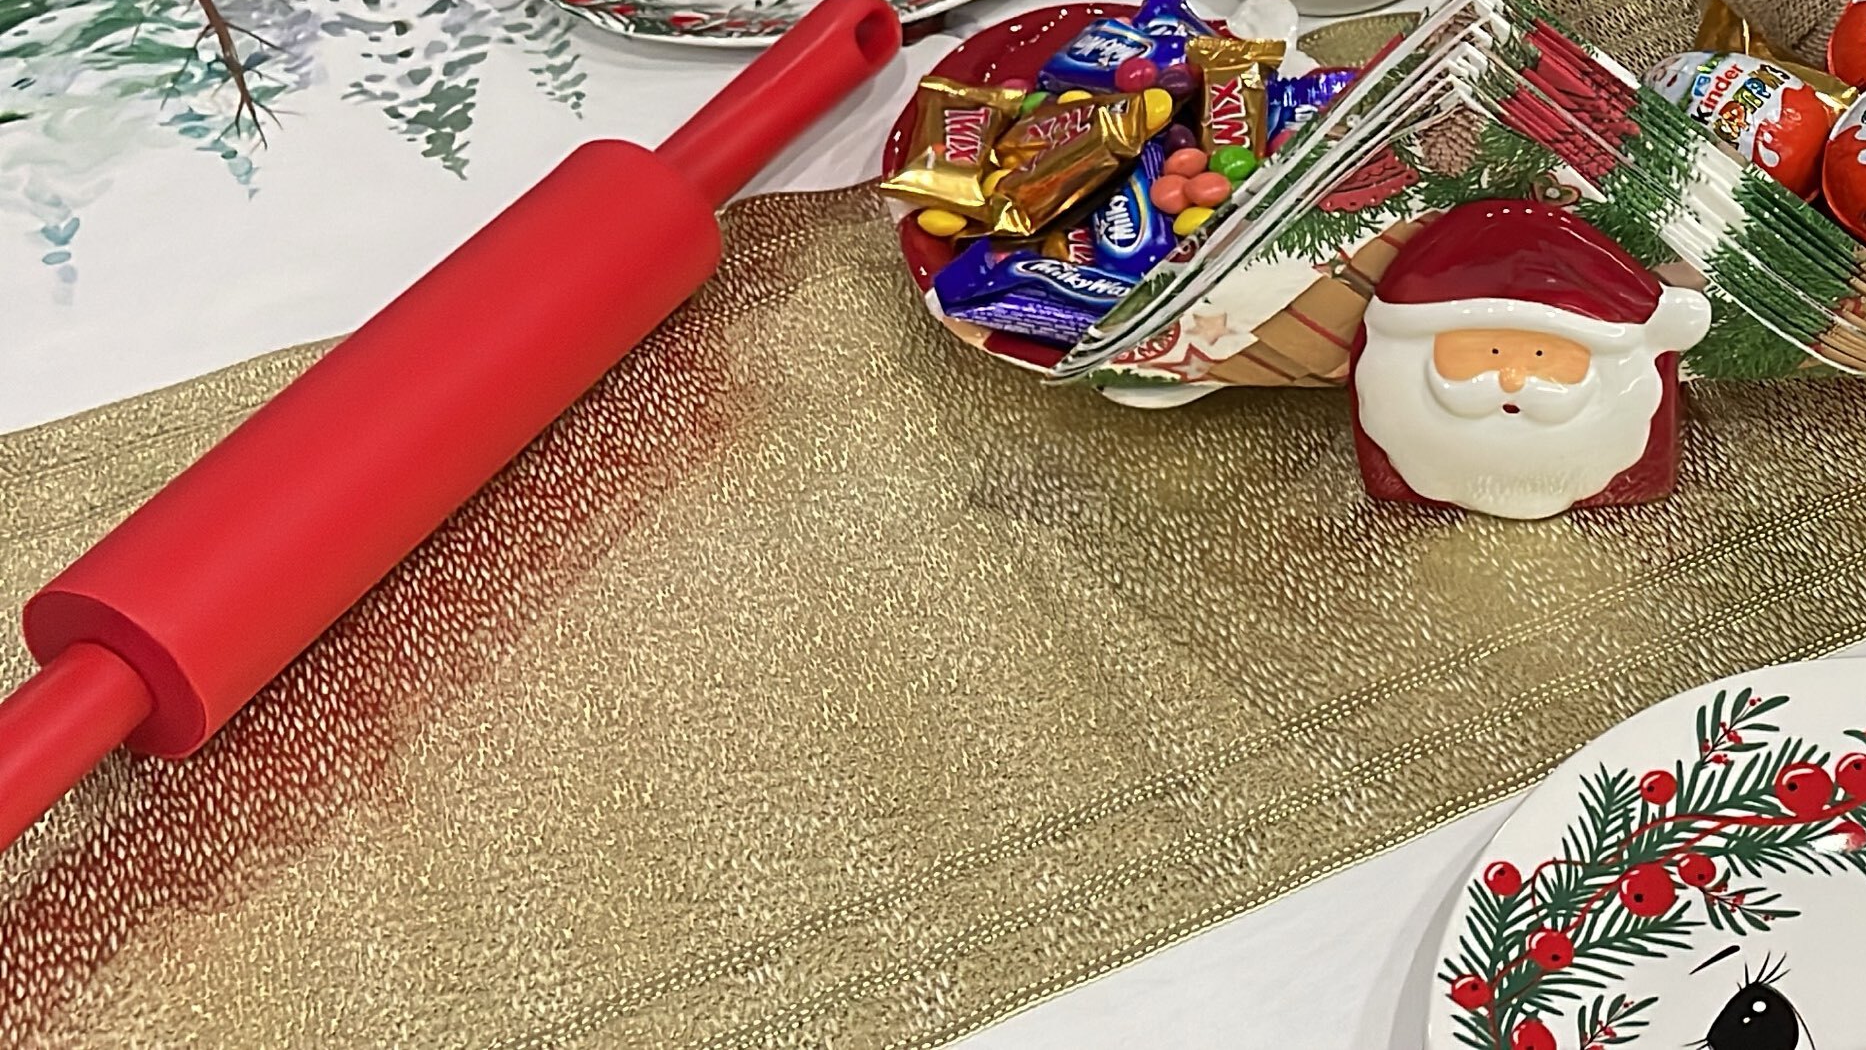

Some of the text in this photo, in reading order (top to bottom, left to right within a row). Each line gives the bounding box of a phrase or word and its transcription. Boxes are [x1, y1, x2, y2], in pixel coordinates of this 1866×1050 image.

[1203, 76, 1251, 148] WIX
[1690, 63, 1744, 126] Kinder
[944, 106, 992, 164] TWIX
[1029, 262, 1094, 289] Milky
